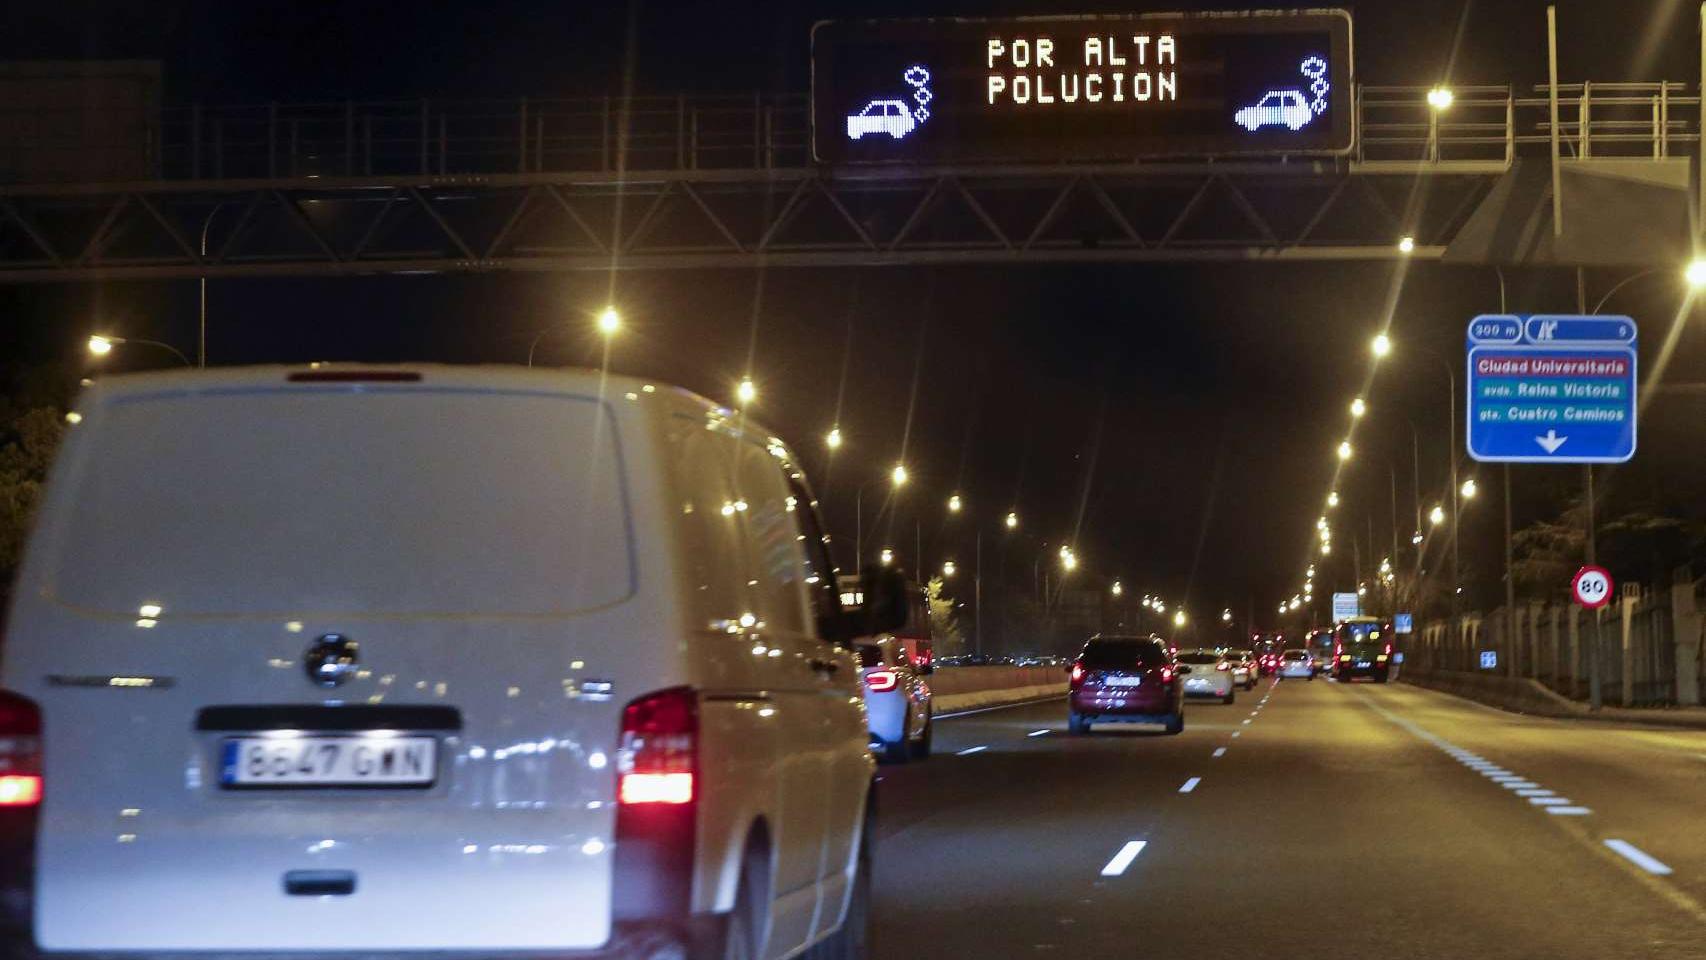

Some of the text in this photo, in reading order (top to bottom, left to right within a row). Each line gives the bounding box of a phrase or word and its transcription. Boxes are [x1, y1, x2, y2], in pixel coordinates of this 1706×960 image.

[988, 35, 1175, 68] POR ALTA
[988, 71, 1176, 104] POLUCION
[1475, 324, 1515, 336] 300 m
[1478, 359, 1624, 374] Ciudad Universitaria
[1518, 383, 1557, 397] Reina
[1564, 383, 1620, 397] Victoria
[1507, 406, 1558, 421] Cuatro
[1563, 406, 1624, 421] Caminos
[1581, 579, 1604, 593] 80
[249, 745, 340, 776] 8647
